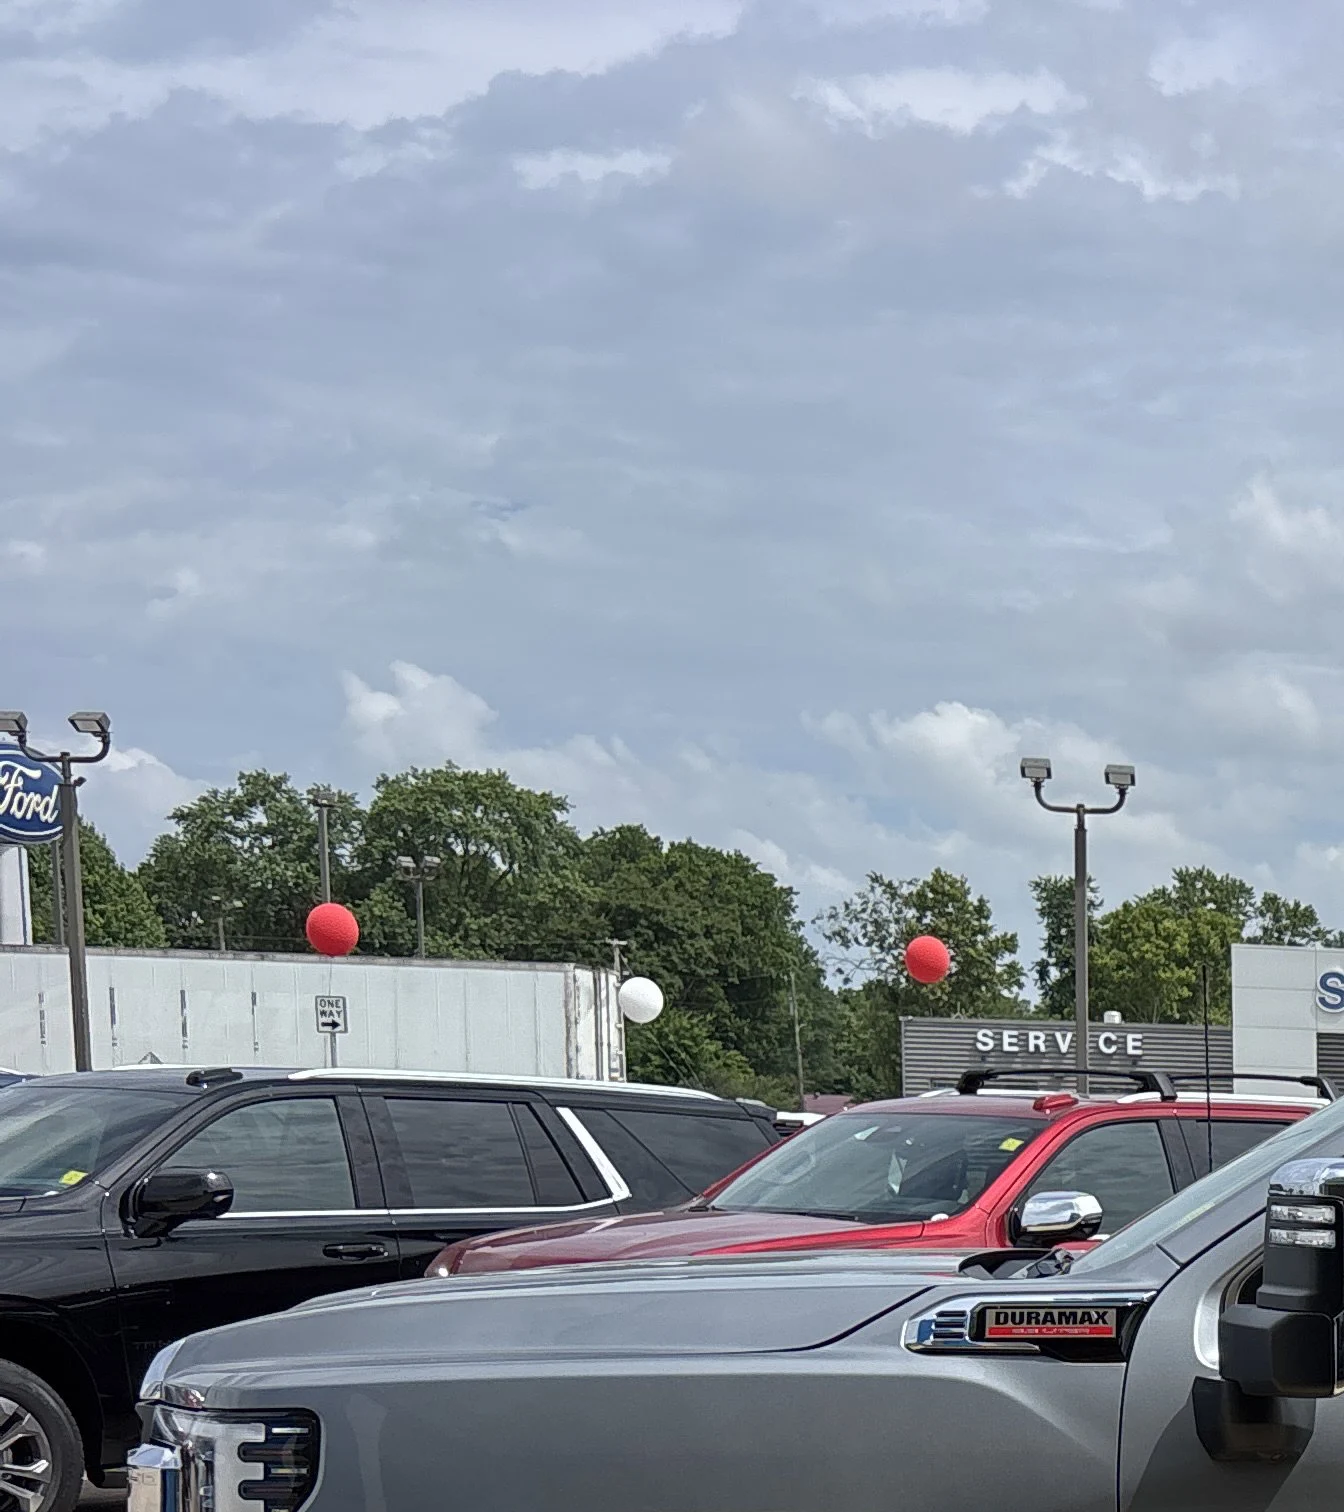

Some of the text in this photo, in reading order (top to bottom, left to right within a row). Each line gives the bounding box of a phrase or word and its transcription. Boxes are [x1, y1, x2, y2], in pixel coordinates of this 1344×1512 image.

[0, 760, 60, 824] Ford
[319, 998, 342, 1009] ONE
[319, 1009, 343, 1019] WAY
[975, 1028, 1144, 1056] SERVCE
[994, 1310, 1109, 1326] DURAMAX
